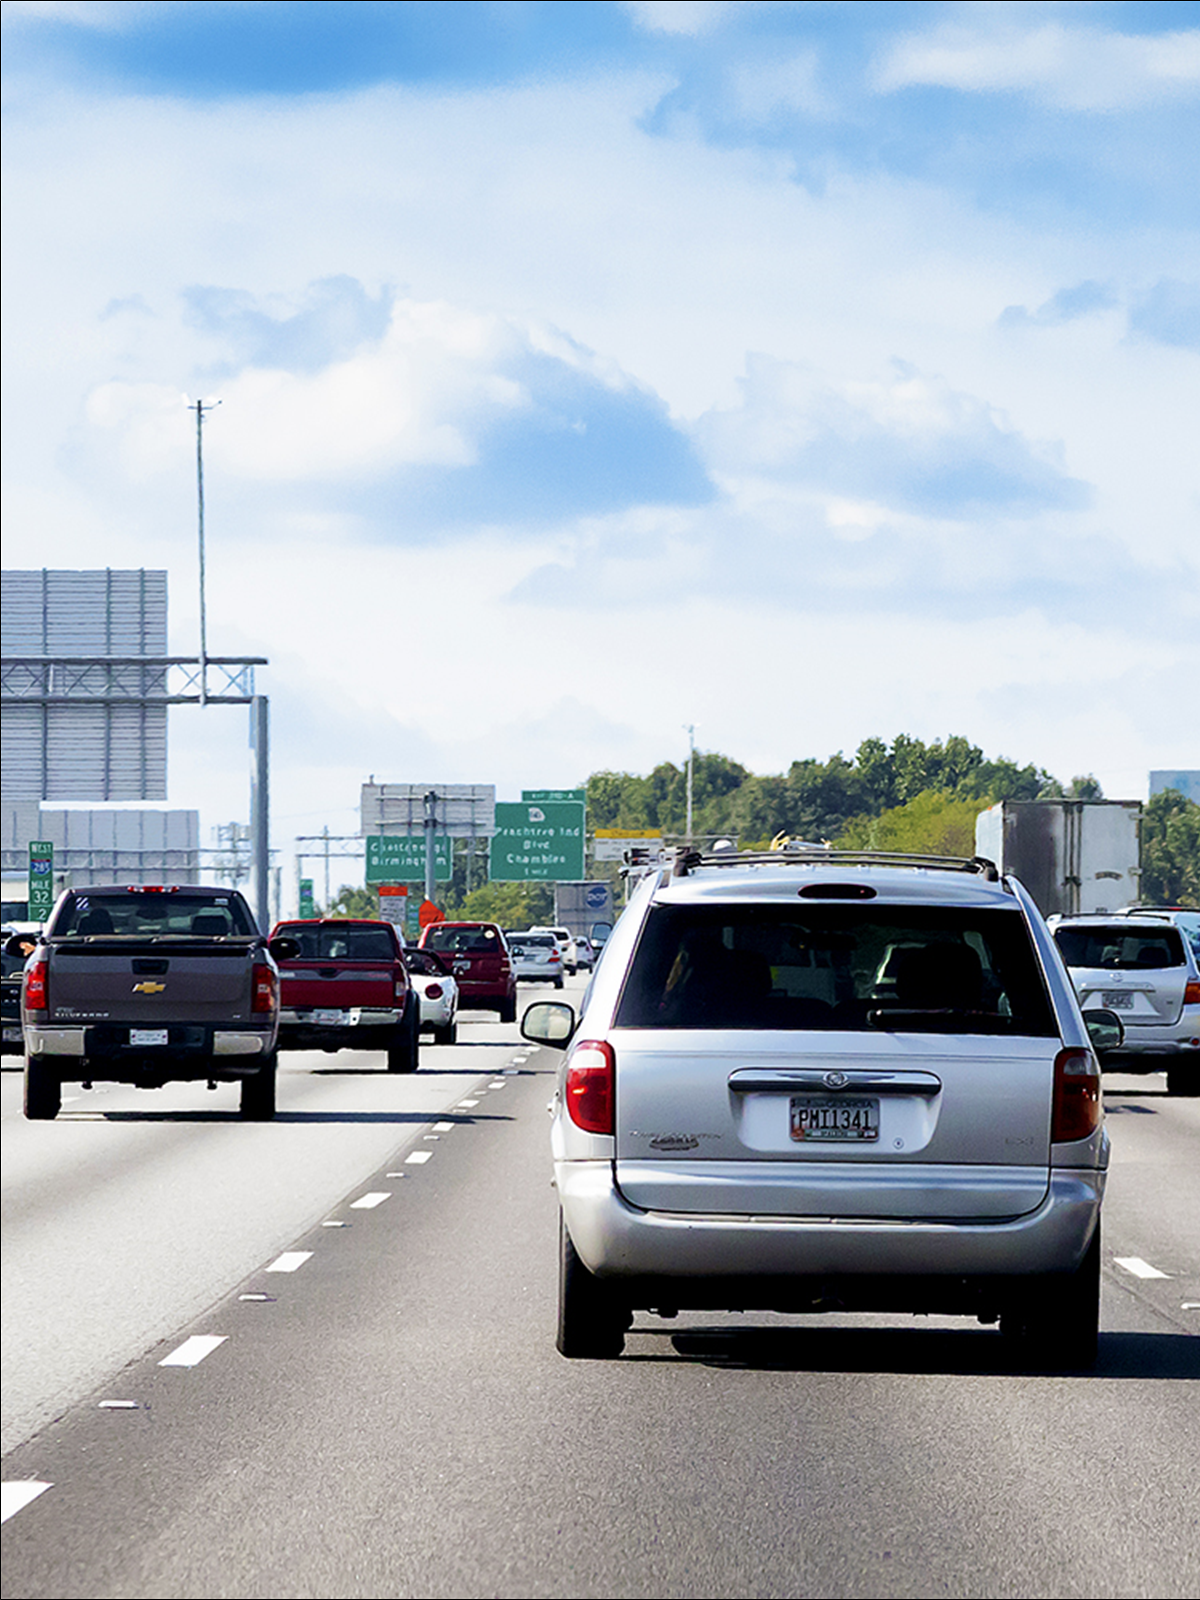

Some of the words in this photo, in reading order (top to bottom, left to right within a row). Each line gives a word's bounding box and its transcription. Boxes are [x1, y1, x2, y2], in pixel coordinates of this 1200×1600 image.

[31, 844, 52, 854] WEST
[371, 856, 447, 867] Birminghm
[31, 880, 50, 890] MILE
[34, 890, 49, 904] 32
[38, 908, 47, 920] 2
[799, 1109, 872, 1130] PMI1341
